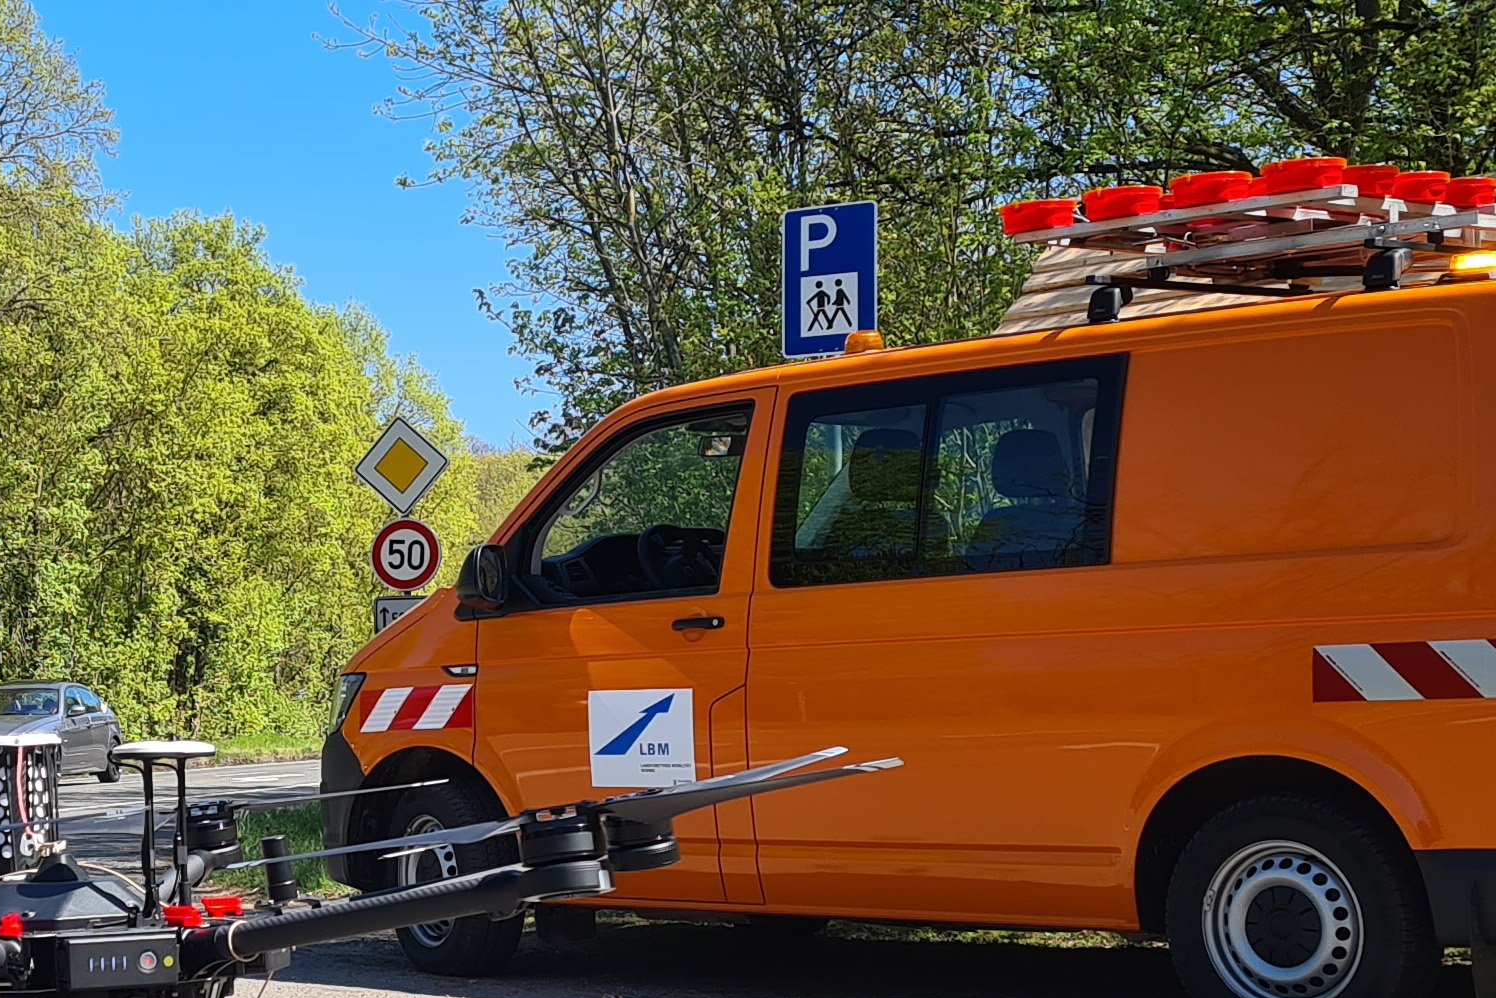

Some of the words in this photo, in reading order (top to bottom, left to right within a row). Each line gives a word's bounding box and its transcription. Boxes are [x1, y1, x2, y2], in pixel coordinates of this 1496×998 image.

[800, 214, 837, 272] P
[387, 539, 425, 571] 50
[639, 742, 670, 756] LBM
